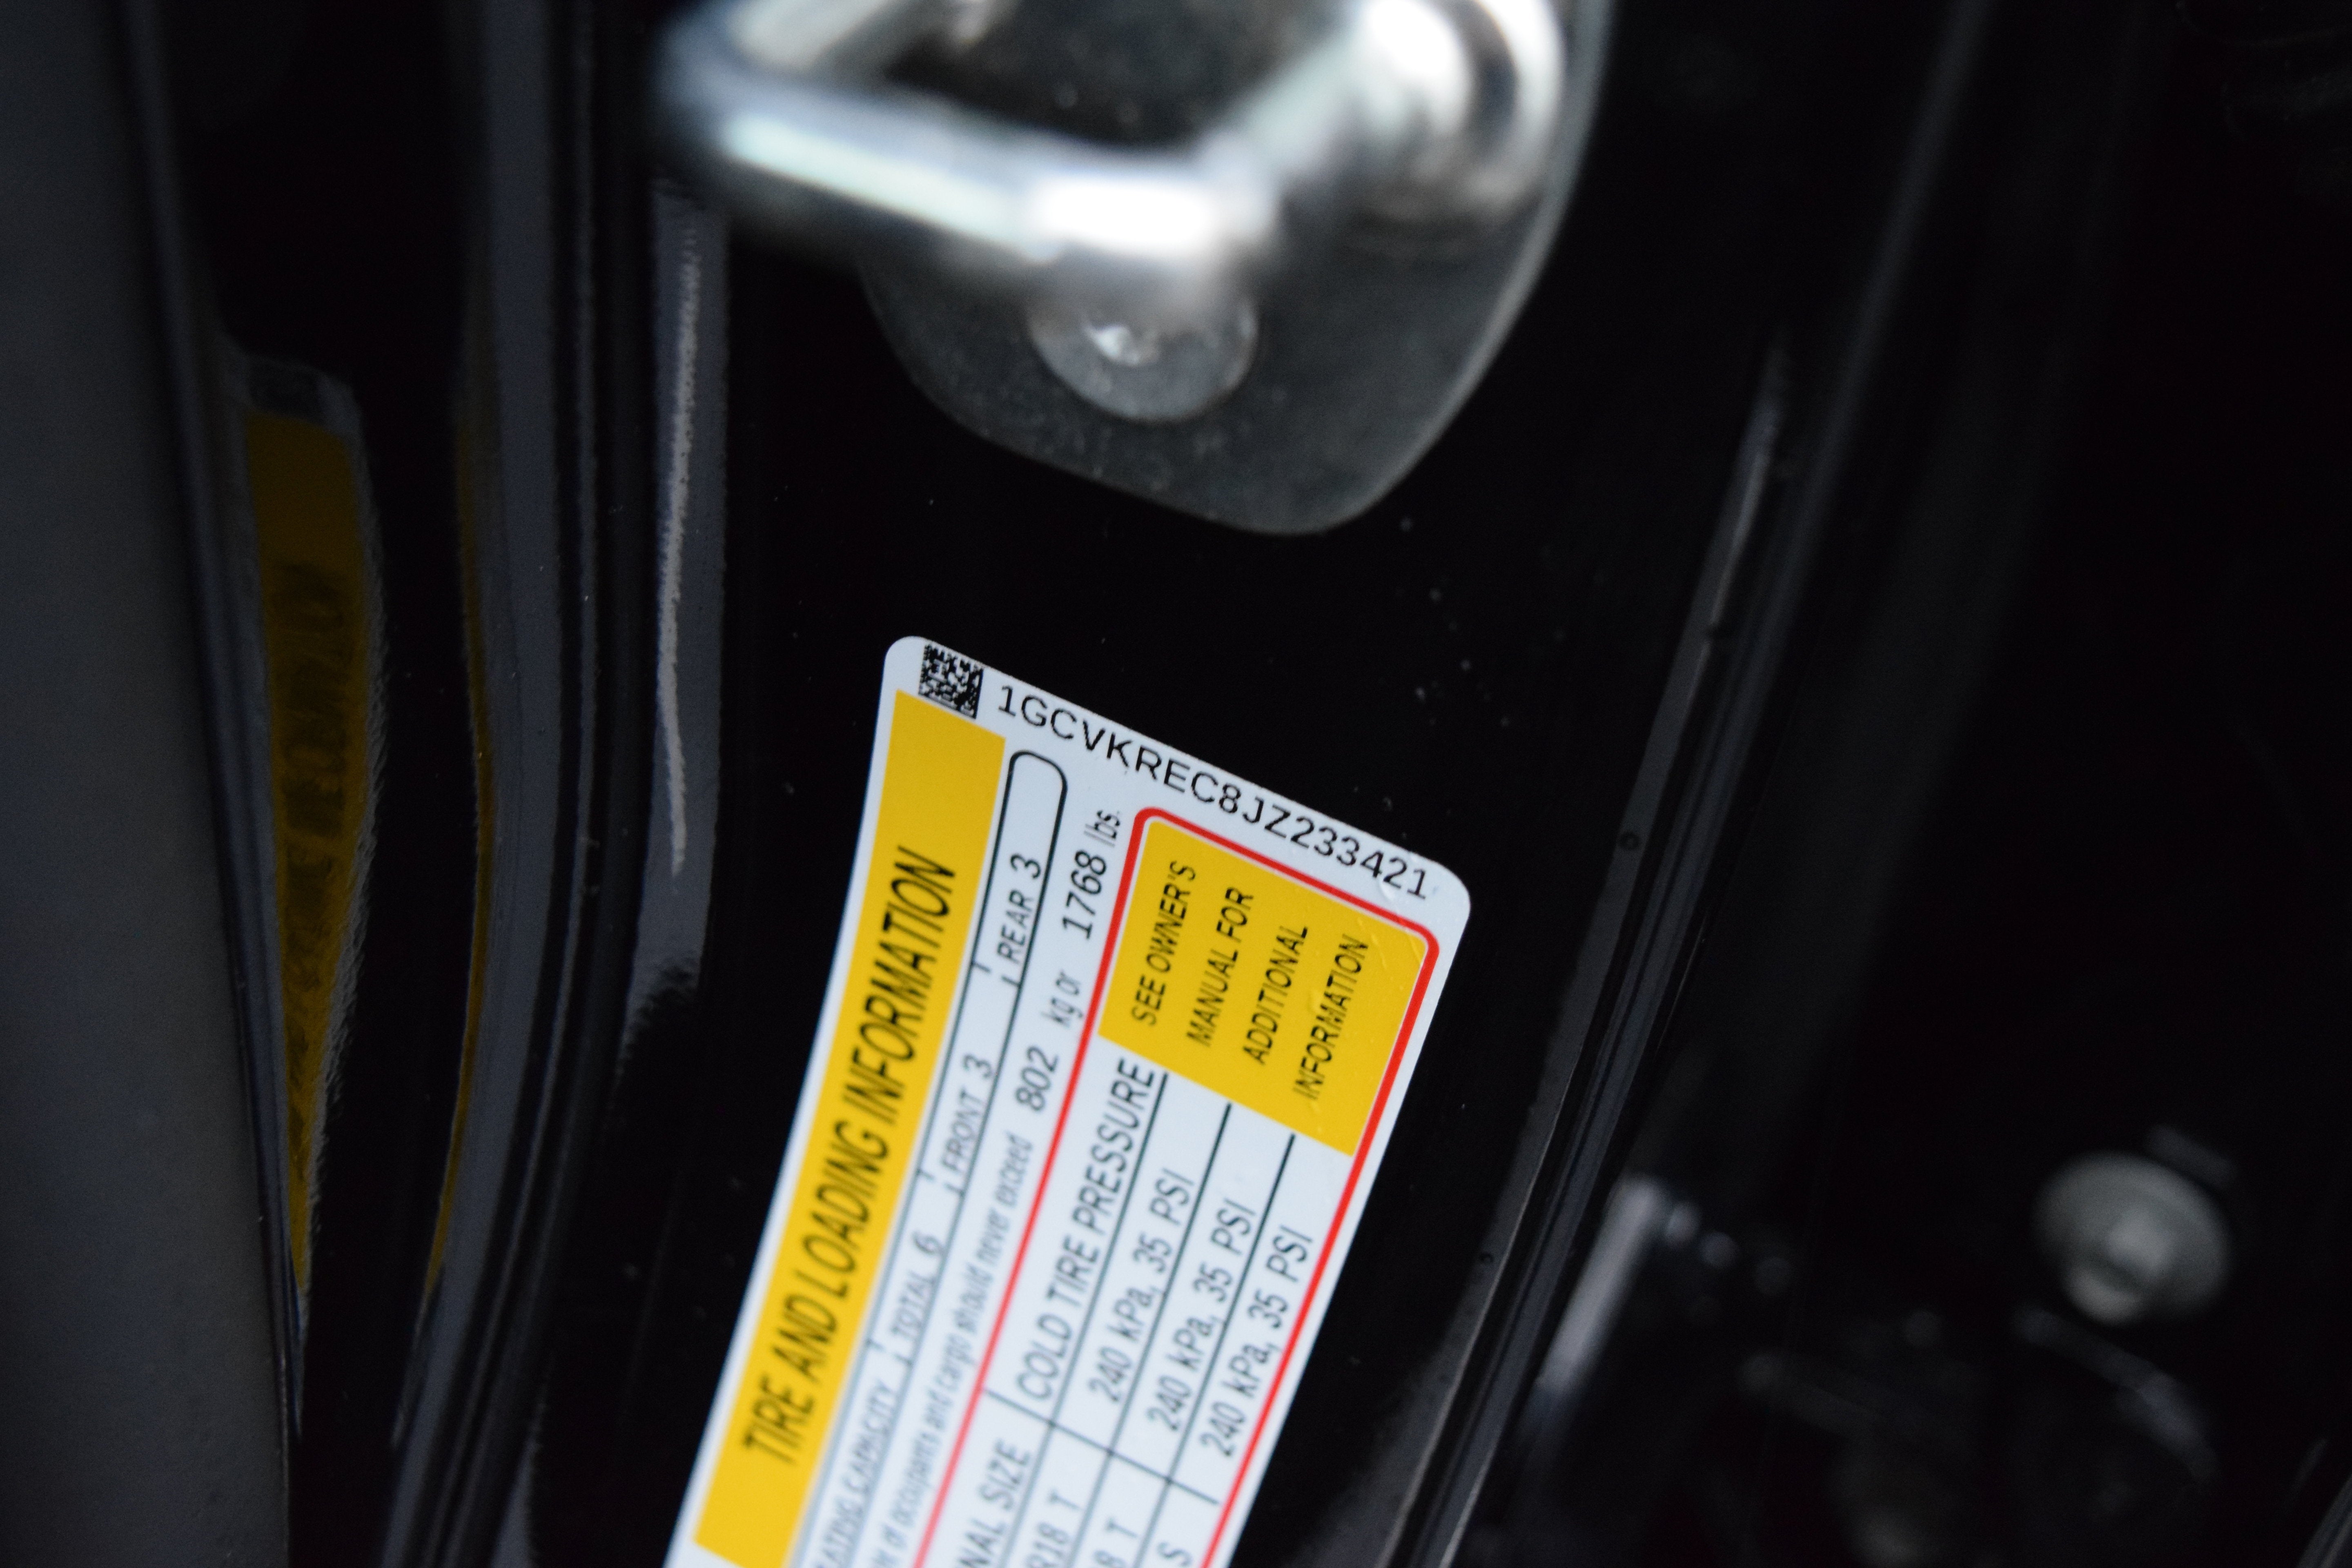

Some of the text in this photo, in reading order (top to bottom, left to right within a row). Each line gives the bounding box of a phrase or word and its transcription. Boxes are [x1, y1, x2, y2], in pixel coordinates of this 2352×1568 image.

[998, 686, 1427, 900] 1GCVKREC8JZ233421
[997, 853, 1041, 964] REAR 3
[1061, 850, 1107, 940] 1768
[1131, 860, 1196, 1025] SEE OWNER'S
[1040, 996, 1083, 1028] kg
[1053, 971, 1080, 996] or
[1186, 887, 1254, 1047] MANUAL FOR
[1242, 925, 1308, 1065] ADDITIONAL
[1292, 933, 1369, 1101] INFORMATION
[940, 1055, 992, 1174] FRONT 3
[1014, 1046, 1058, 1112] 802
[741, 845, 956, 1467] TIRE AND LOADING INFORMATION
[992, 1131, 1034, 1209] exceed
[970, 1208, 1011, 1268] never
[1016, 1057, 1154, 1402] COLD TIRE PRESSURE
[890, 1232, 942, 1343] TOTAL 6
[948, 1263, 995, 1334] should
[1087, 1168, 1194, 1403] 240 kPa, 35 PSI
[1146, 1198, 1256, 1432] 240 kPa, 35 PSI
[1198, 1225, 1313, 1457] 240 kPa, 35 PSI
[976, 1439, 1030, 1511] SIZE
[1047, 1489, 1081, 1511] T
[1105, 1516, 1138, 1539] T
